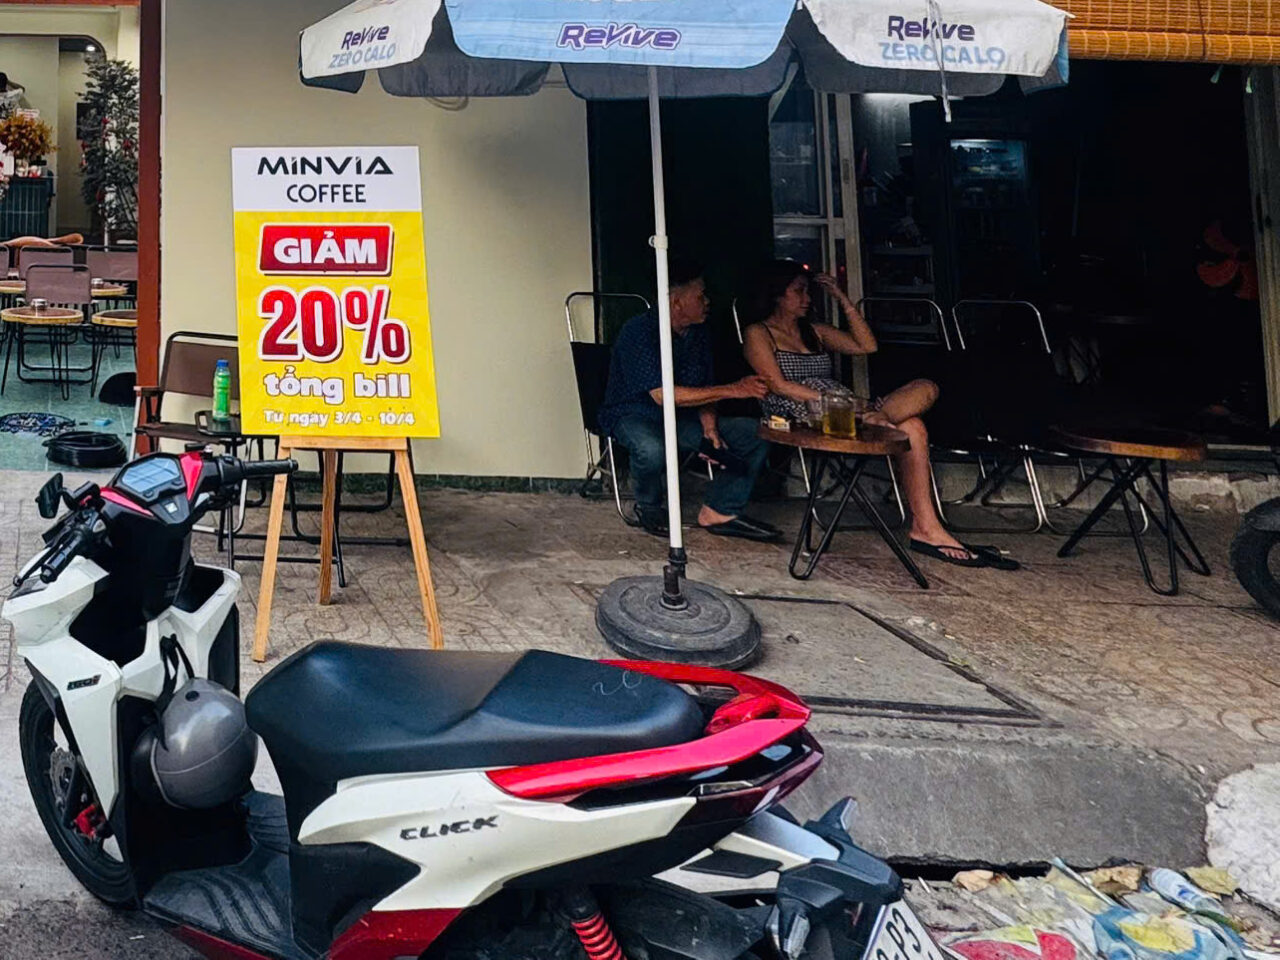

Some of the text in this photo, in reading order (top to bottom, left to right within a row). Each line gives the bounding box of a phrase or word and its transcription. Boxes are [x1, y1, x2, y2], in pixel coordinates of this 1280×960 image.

[328, 43, 397, 69] ZERO CALO
[879, 42, 1006, 66] ZERO CALO
[257, 156, 394, 175] MINVIA
[287, 184, 367, 203] COFFEE
[273, 230, 378, 265] GIẢM
[259, 285, 412, 365] 20%
[353, 372, 412, 398] bill
[334, 410, 362, 425] 3/4
[379, 411, 416, 426] 10/4
[400, 815, 499, 840] CLICK
